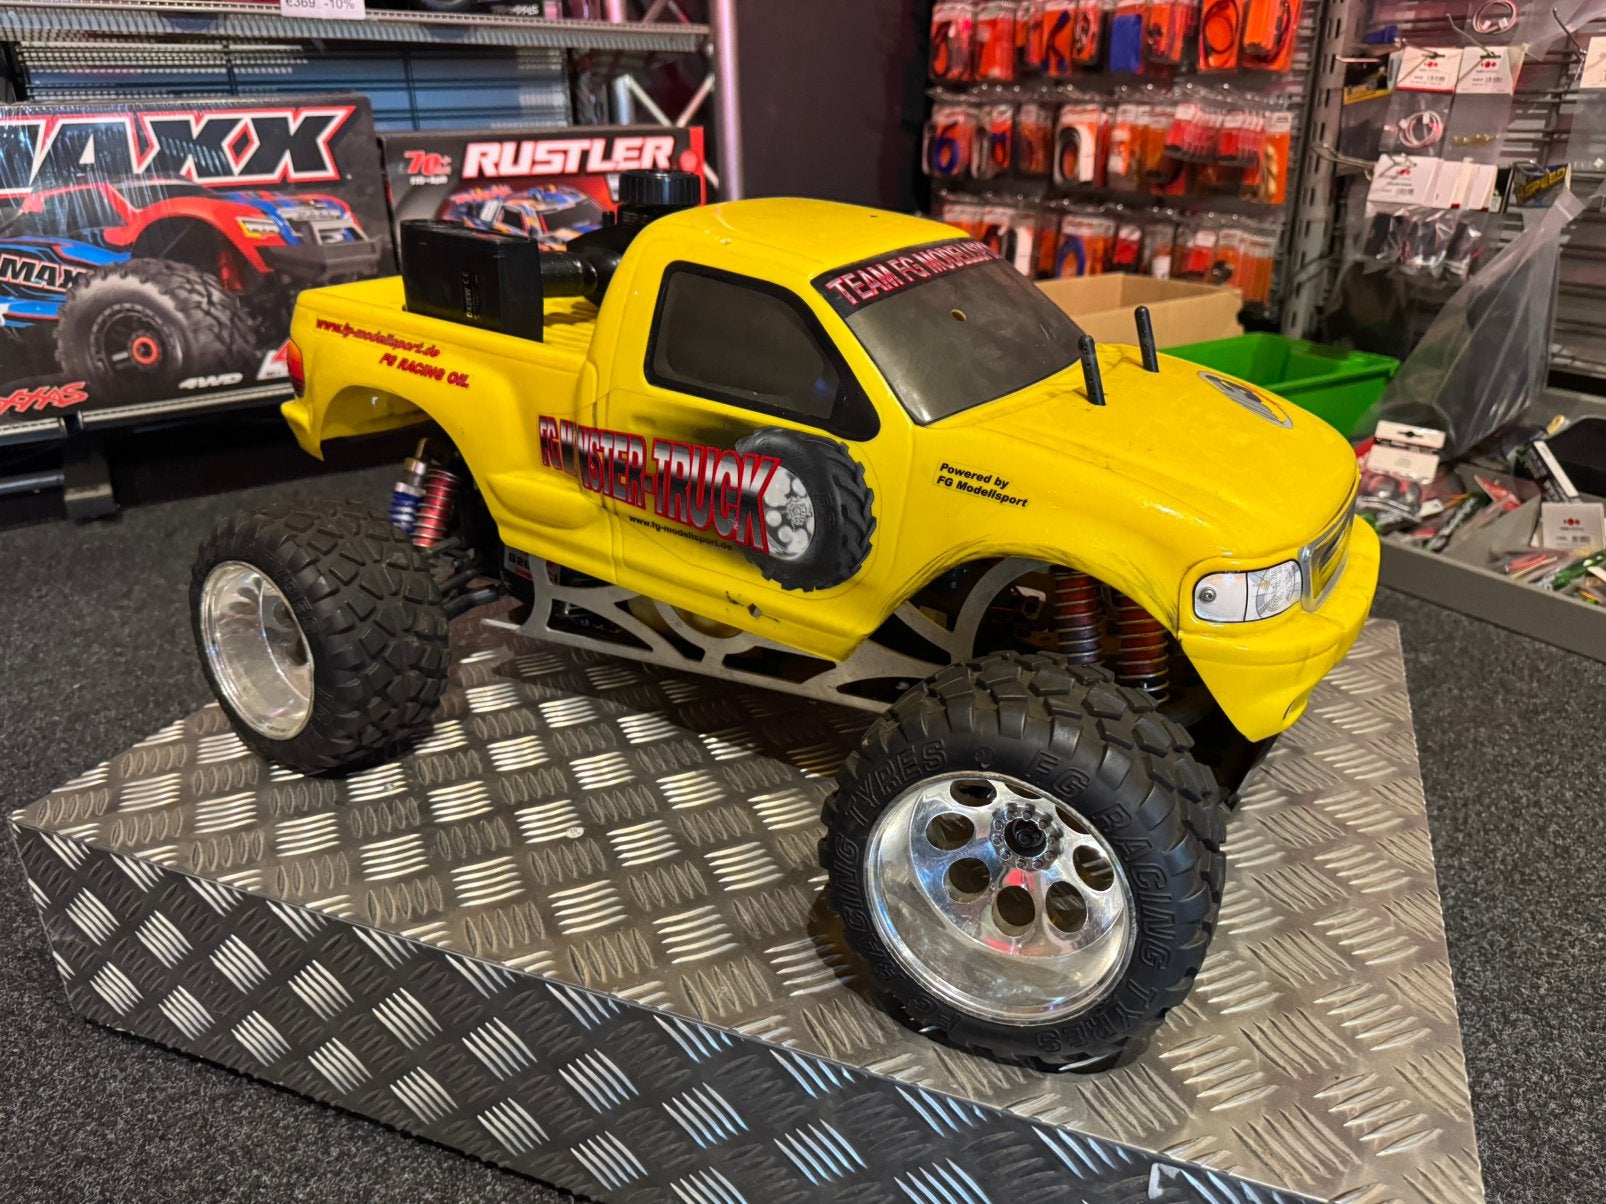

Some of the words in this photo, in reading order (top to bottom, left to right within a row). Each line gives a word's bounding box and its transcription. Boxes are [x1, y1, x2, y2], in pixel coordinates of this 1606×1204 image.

[462, 135, 675, 179] RUSTLER
[824, 262, 905, 306] TEAM
[886, 256, 932, 283] FG
[179, 373, 243, 390] 4WD
[379, 352, 398, 367] FG
[396, 357, 446, 381] RACING
[447, 371, 470, 389] OIL
[936, 475, 955, 487] FG
[955, 480, 1029, 508] Modellsport
[939, 462, 993, 484] Powered
[993, 476, 1010, 490] by
[628, 515, 733, 551] www.fg-modellsport.de
[844, 739, 947, 826] TYRES
[1023, 750, 1090, 800] FG
[1090, 804, 1176, 971] RACING
